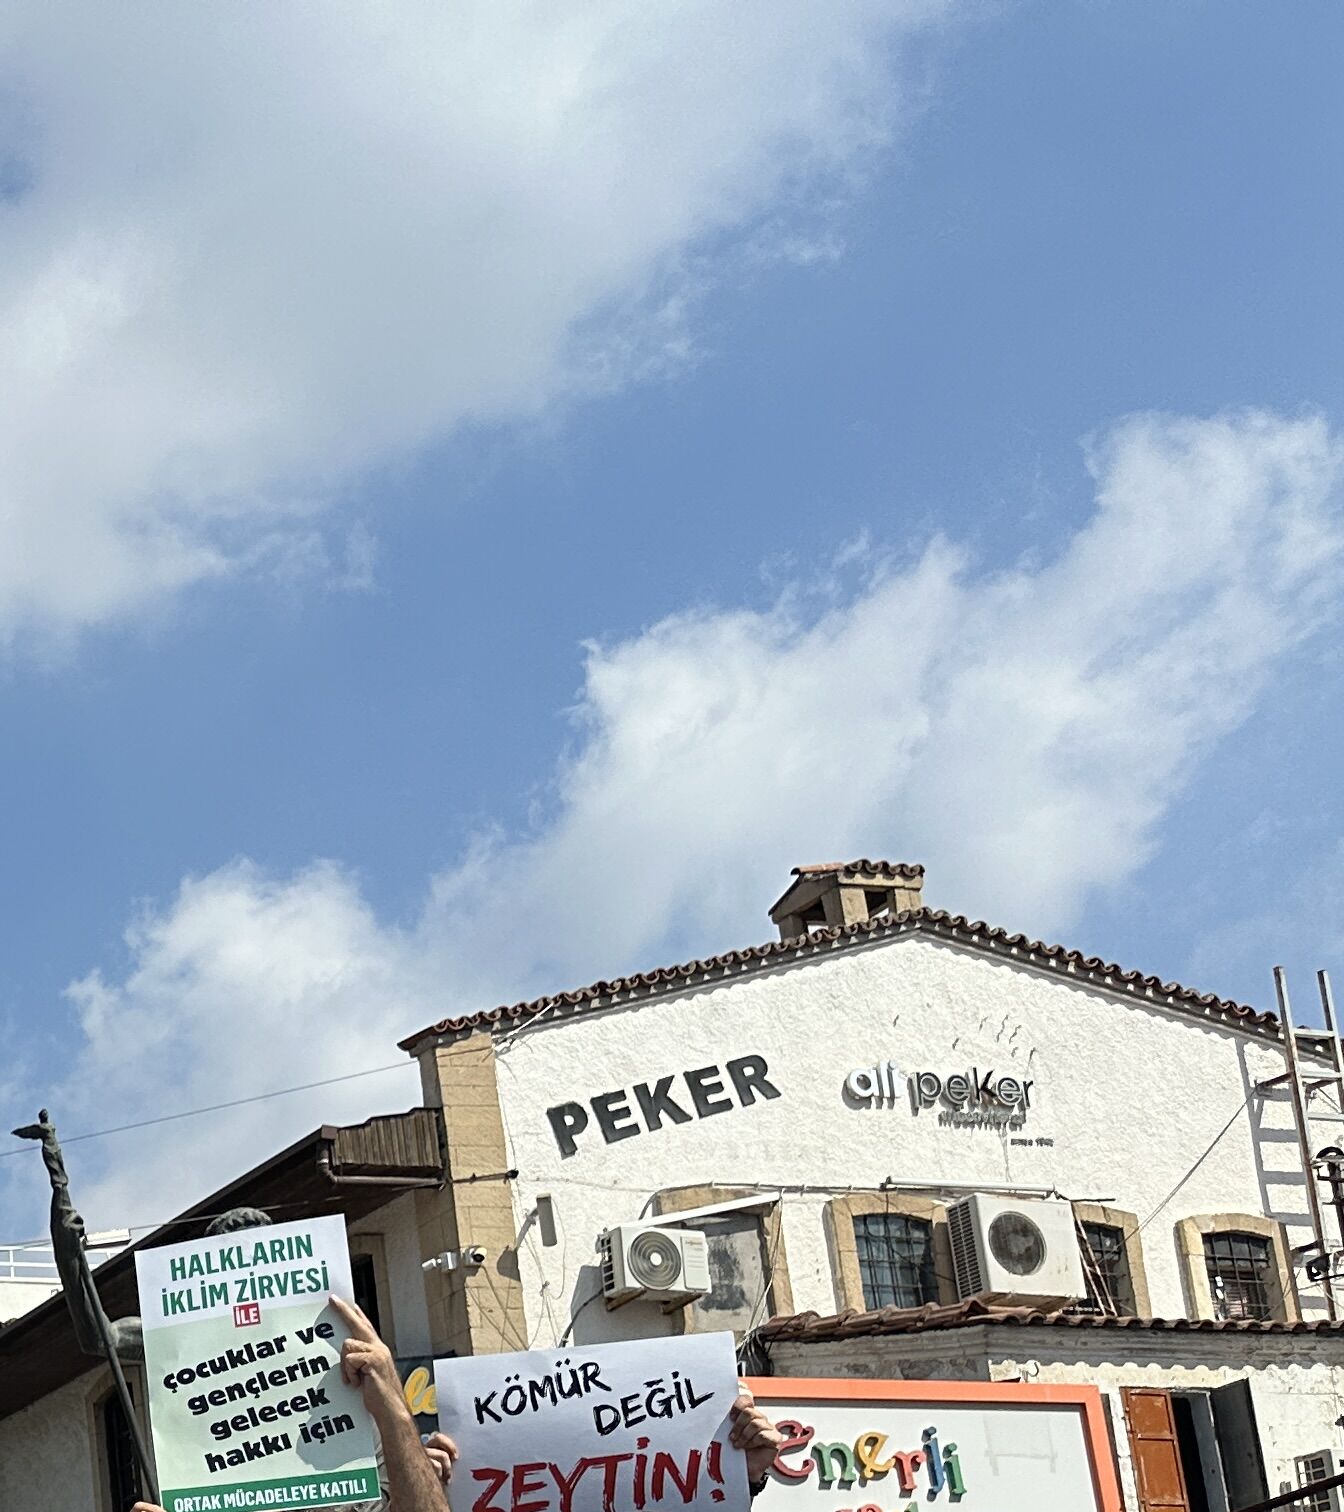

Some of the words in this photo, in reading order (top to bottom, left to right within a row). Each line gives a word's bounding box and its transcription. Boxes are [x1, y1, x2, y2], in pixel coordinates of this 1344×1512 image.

[547, 1054, 783, 1160] PEKER
[913, 1066, 1034, 1109] peker
[170, 1235, 313, 1281] HALKLARIN
[162, 1281, 229, 1317] İKLİM
[234, 1261, 330, 1303] ZİRVESİ
[163, 1334, 287, 1393] çocuklar
[295, 1321, 335, 1346] ve
[187, 1355, 330, 1416] gençlerin
[210, 1386, 331, 1441] gelecek
[474, 1358, 612, 1425] KÖMÜR
[593, 1371, 715, 1436] DEĞİL
[204, 1431, 293, 1474] hakkı
[299, 1413, 355, 1444] için
[174, 1496, 221, 1512] ORTAK
[224, 1486, 318, 1508] MÜCADELEYE
[320, 1478, 367, 1497] KATIL!
